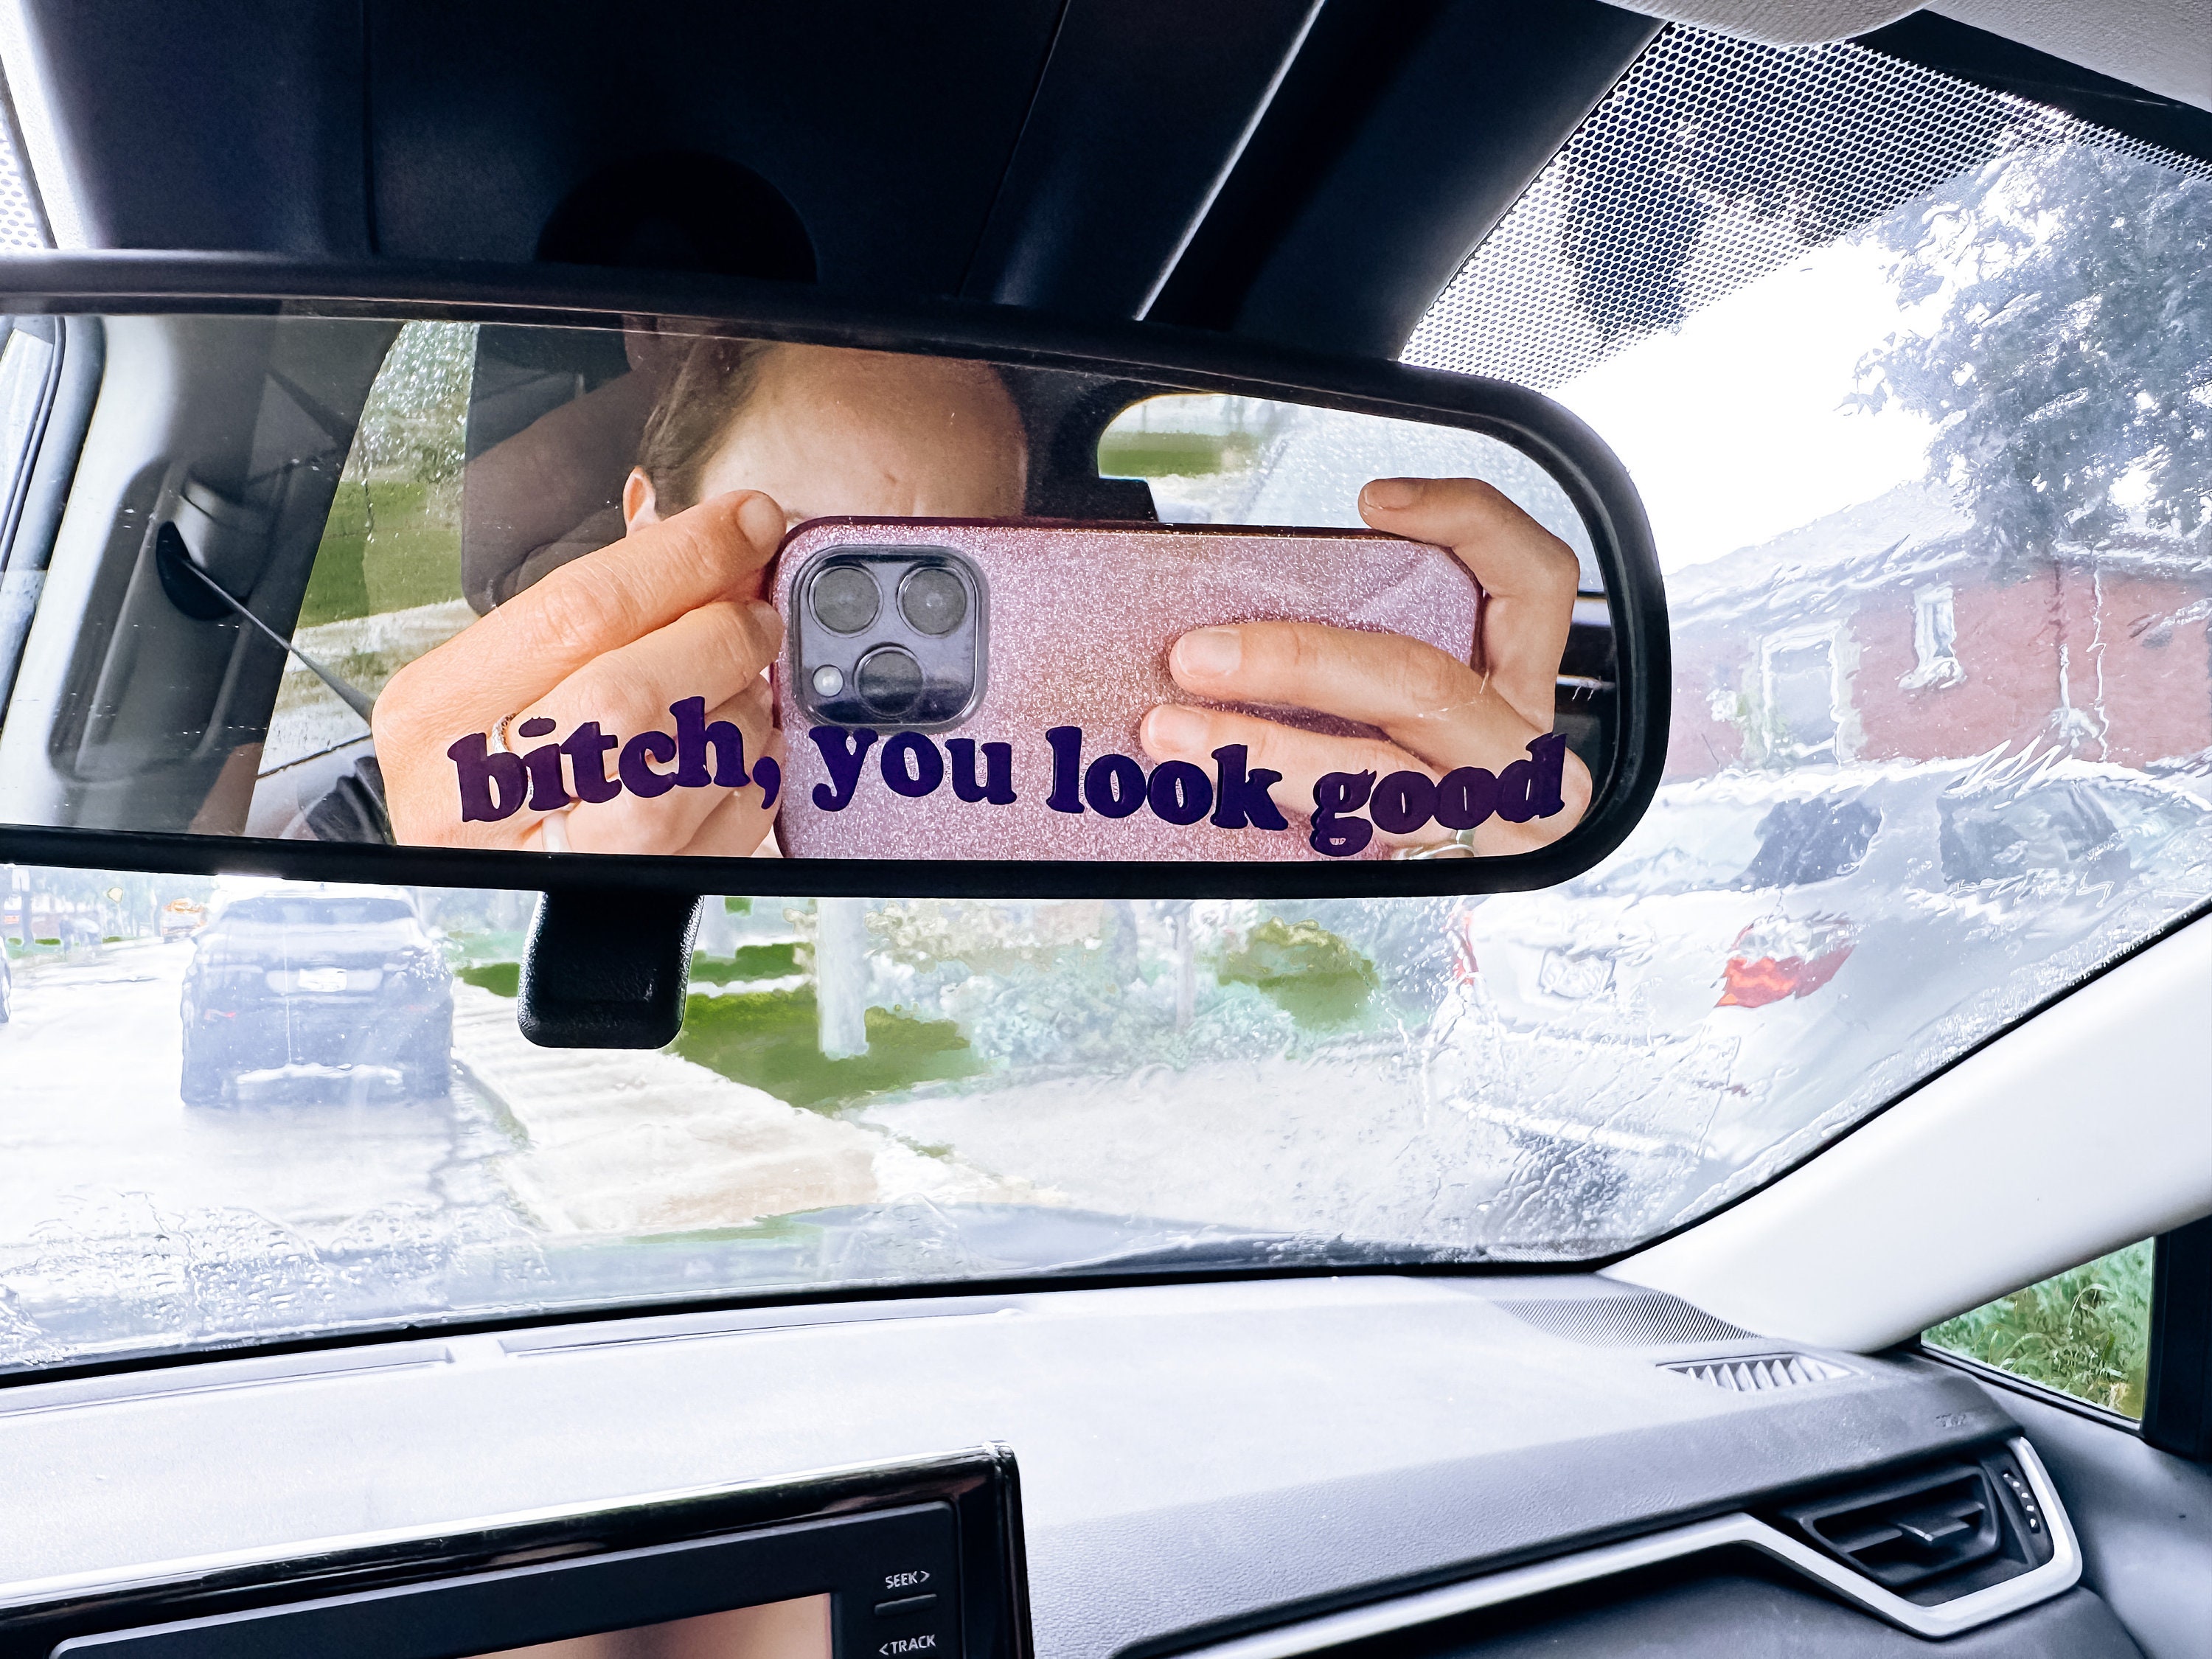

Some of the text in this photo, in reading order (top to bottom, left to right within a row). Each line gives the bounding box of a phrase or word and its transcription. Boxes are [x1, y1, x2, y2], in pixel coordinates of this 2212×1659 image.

[447, 695, 1568, 858] bitch, you look good
